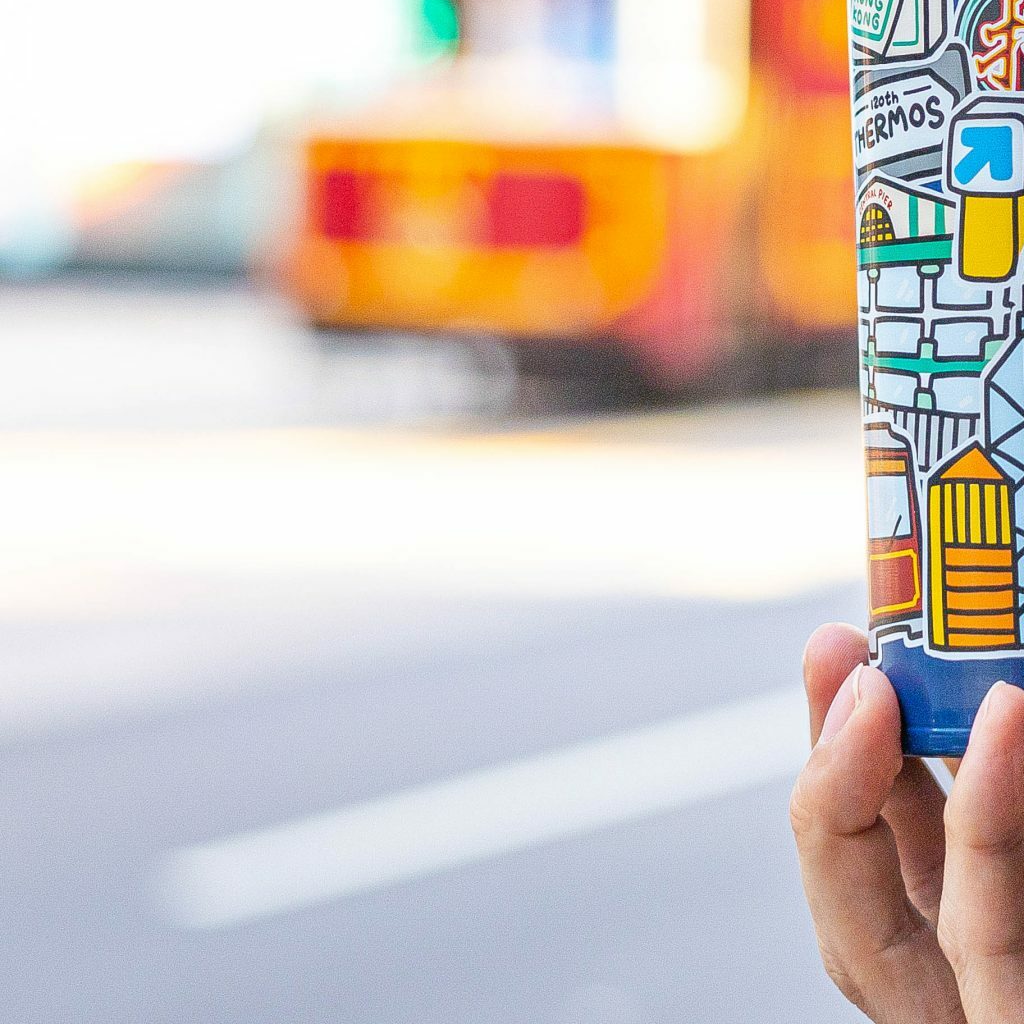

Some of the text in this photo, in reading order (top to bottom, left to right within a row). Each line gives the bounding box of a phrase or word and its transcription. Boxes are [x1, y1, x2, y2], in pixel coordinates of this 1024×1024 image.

[852, 6, 881, 30] KONG
[870, 90, 900, 110] 120th
[878, 188, 893, 211] PIER
